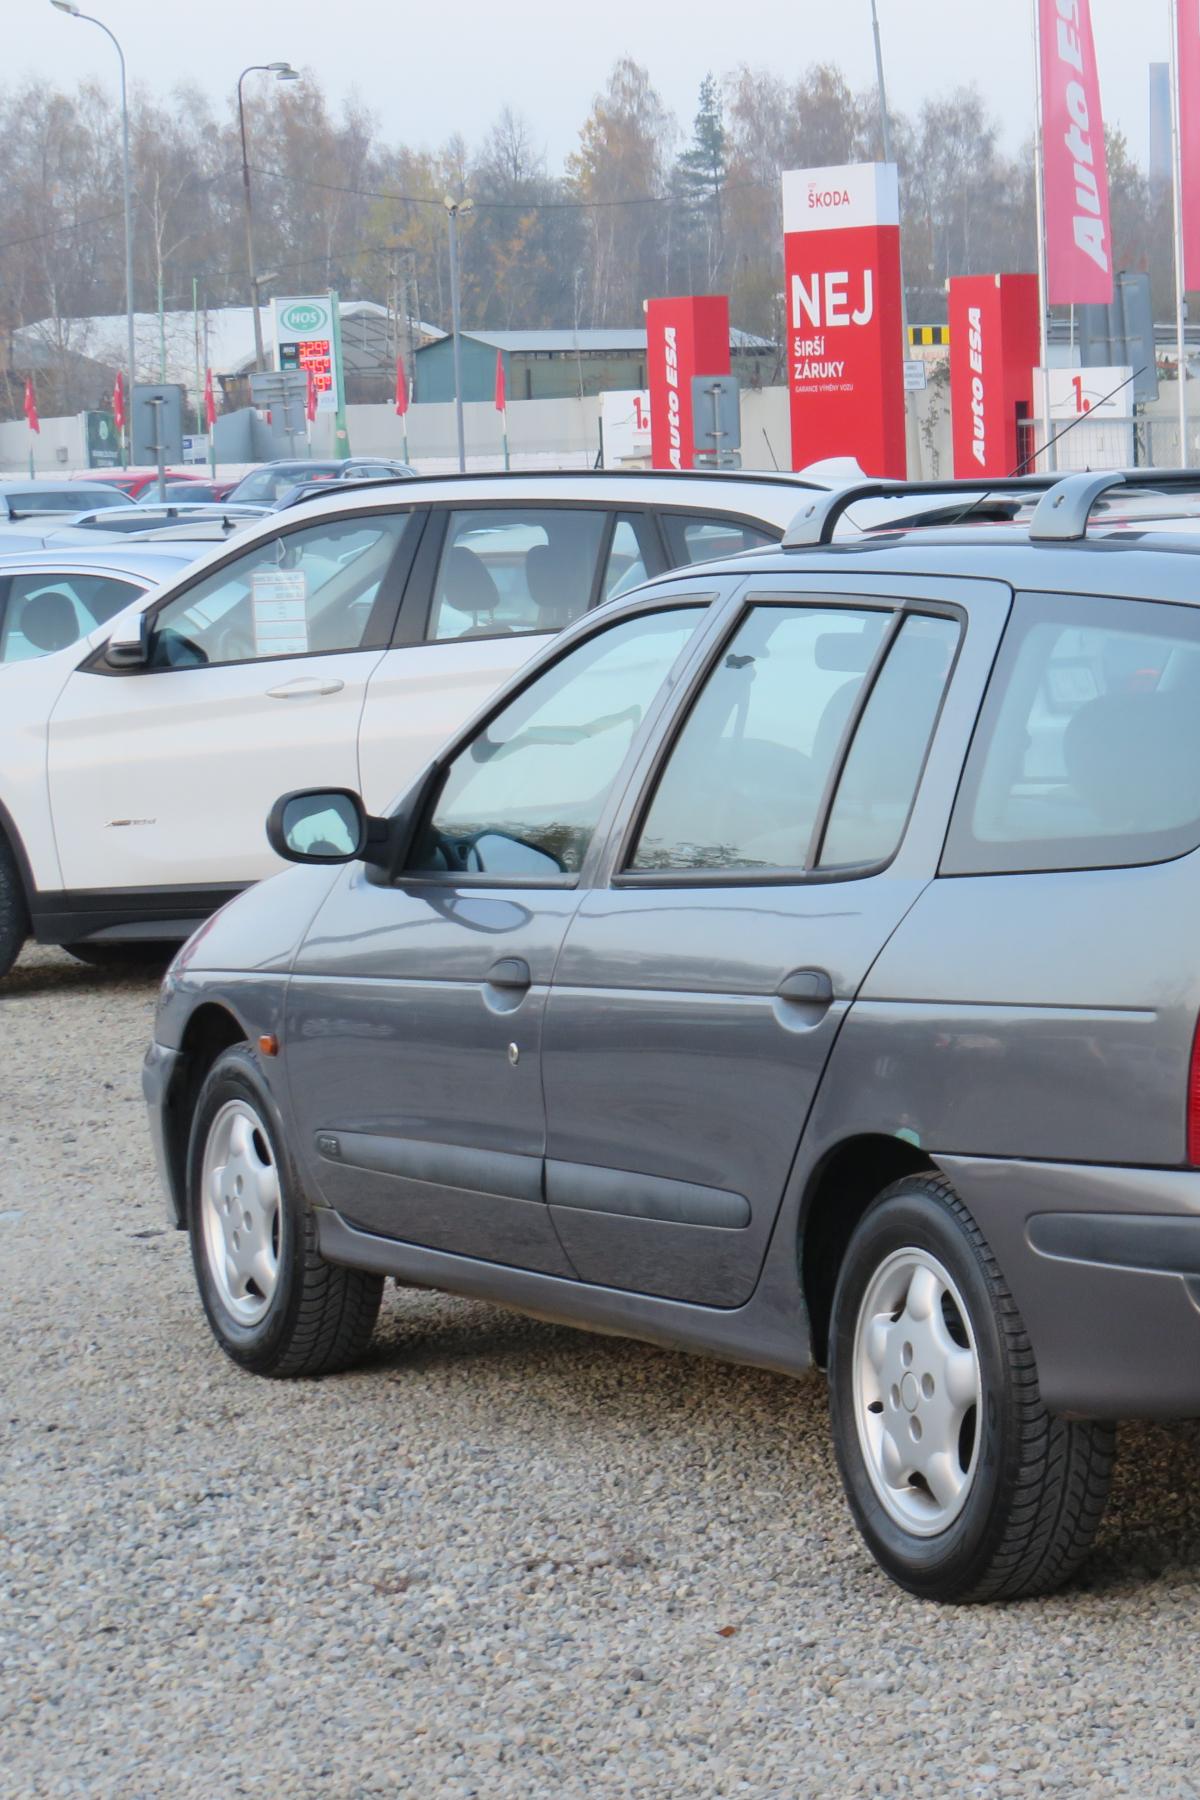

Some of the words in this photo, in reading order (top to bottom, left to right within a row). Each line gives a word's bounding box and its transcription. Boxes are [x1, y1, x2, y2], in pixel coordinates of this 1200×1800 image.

[808, 189, 851, 209] ŠKODA
[1064, 80, 1108, 273] Auto
[791, 269, 874, 329] NEJ
[664, 327, 678, 388] ESA
[794, 336, 825, 357] ŠIRŠÍ
[794, 359, 846, 380] ZÁRUKY
[968, 307, 983, 375] ESA
[668, 390, 682, 469] Auto
[971, 377, 986, 467] Auto
